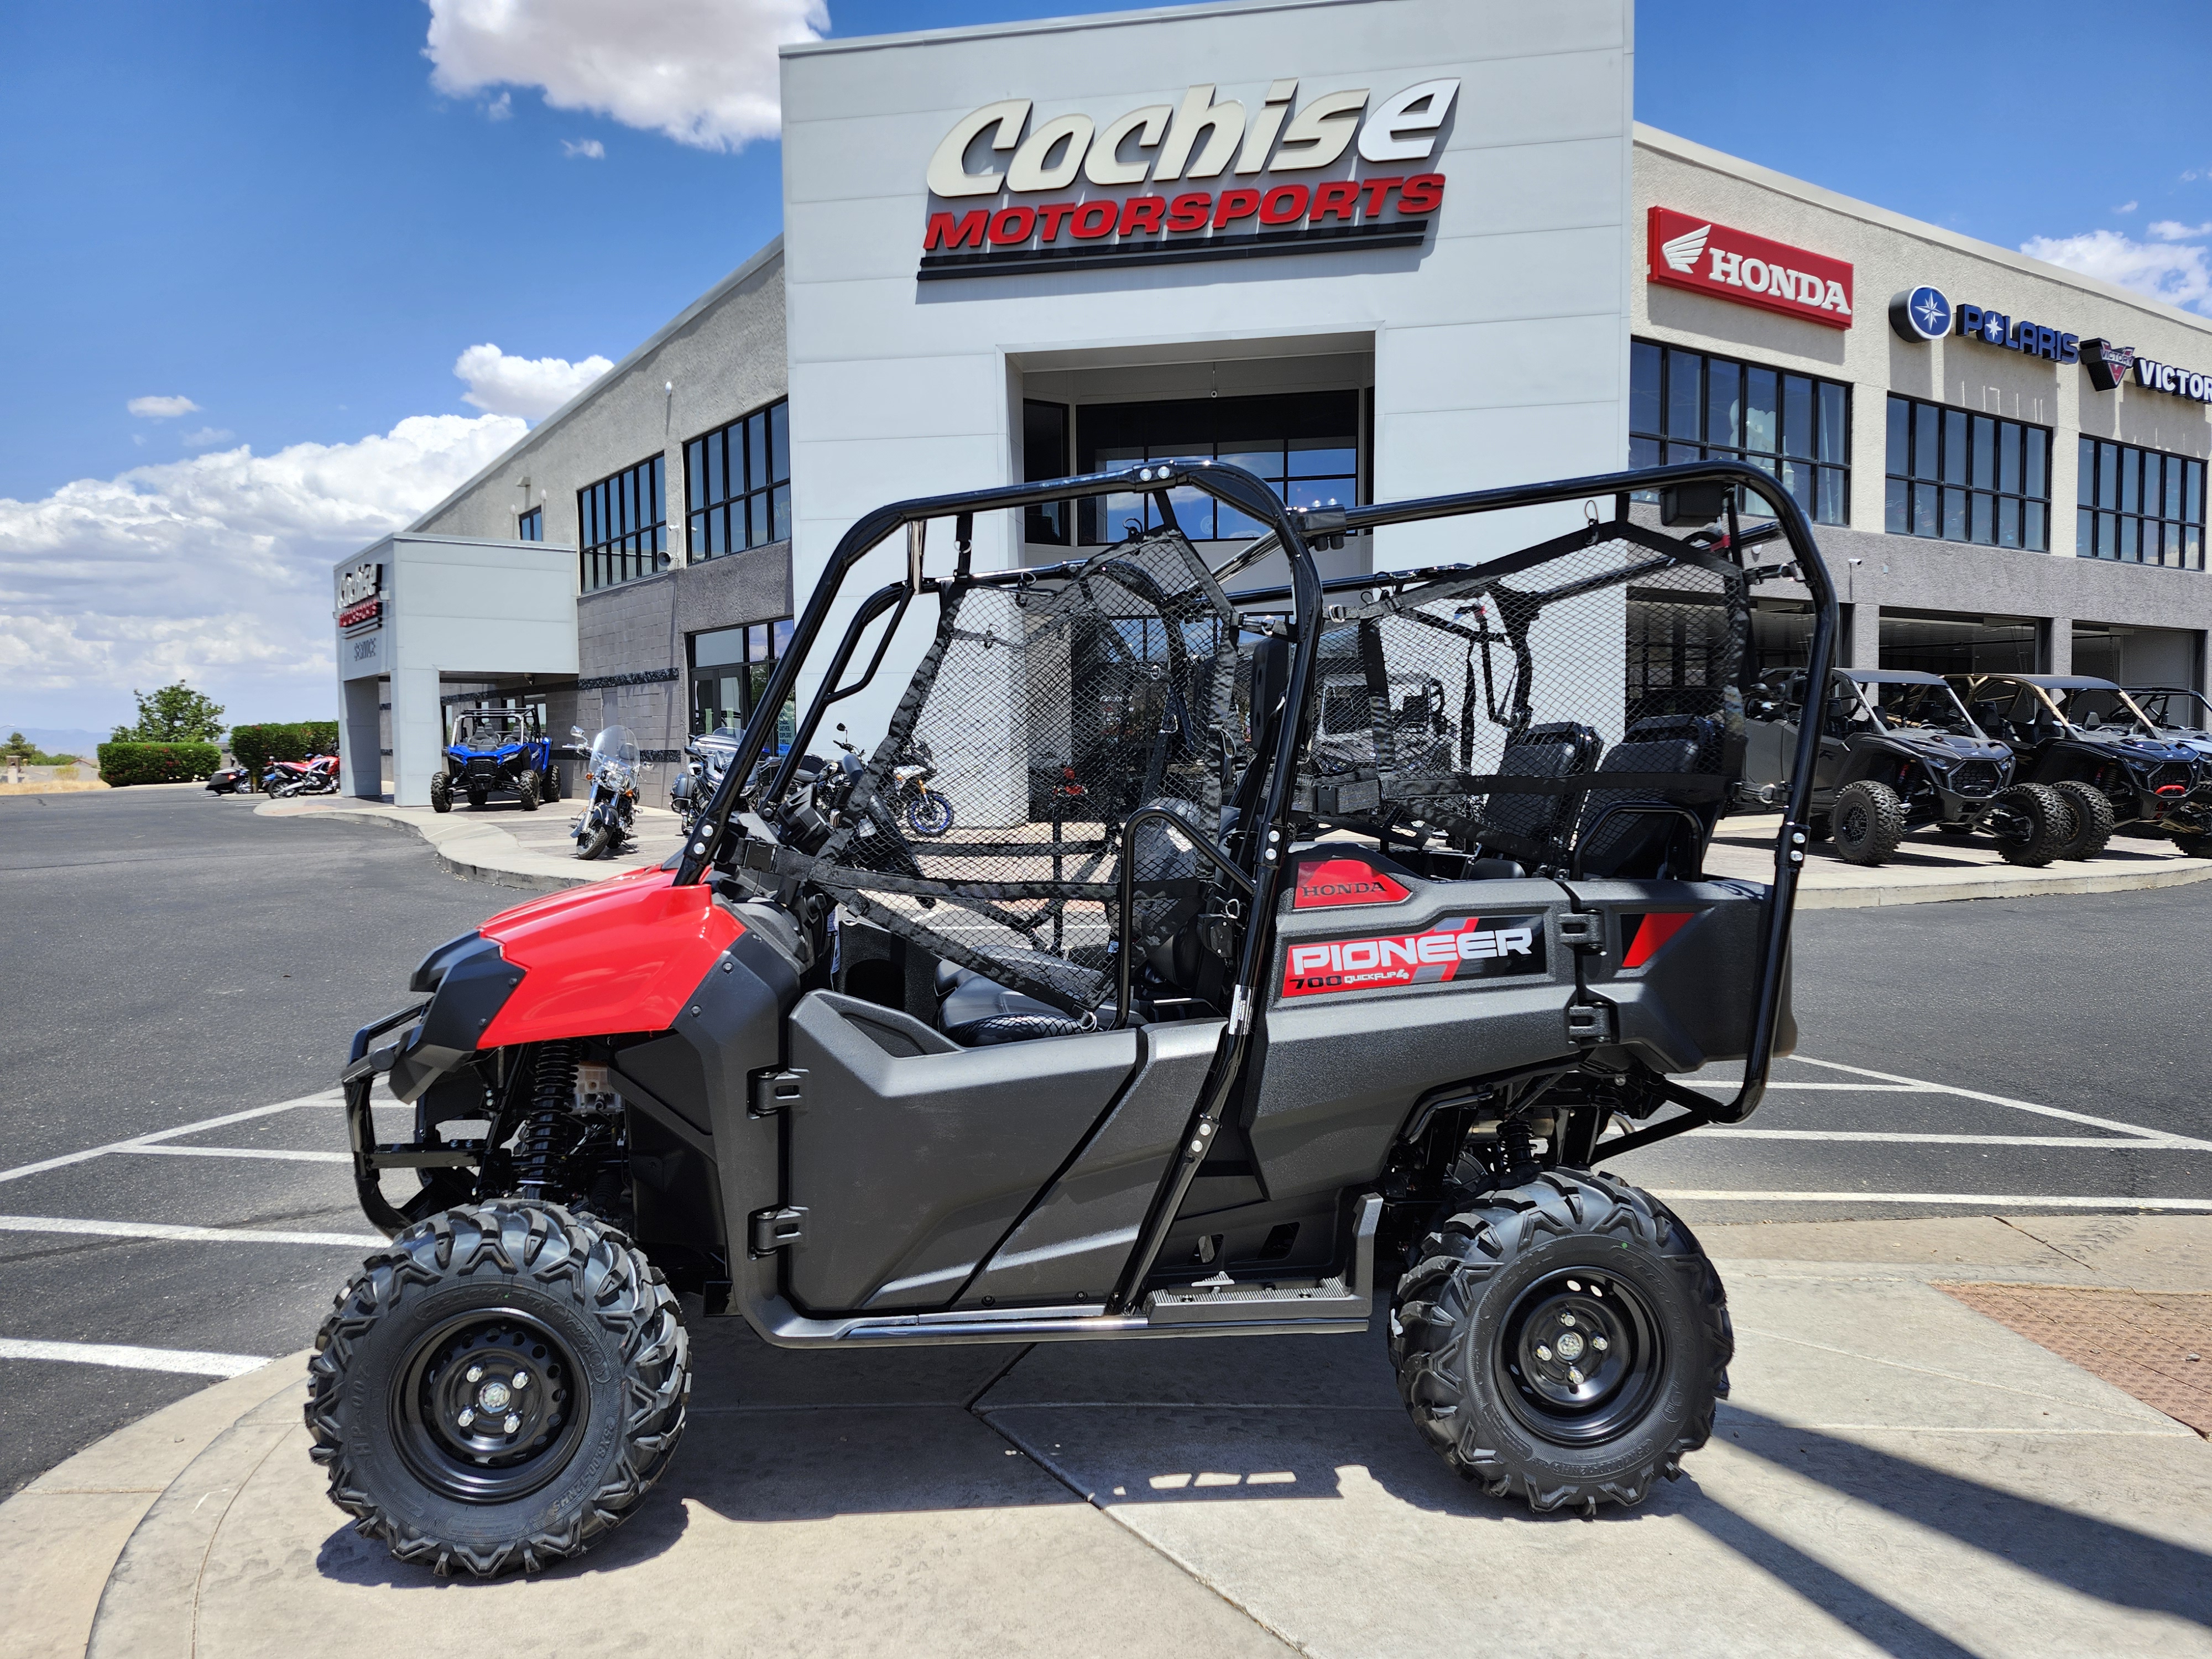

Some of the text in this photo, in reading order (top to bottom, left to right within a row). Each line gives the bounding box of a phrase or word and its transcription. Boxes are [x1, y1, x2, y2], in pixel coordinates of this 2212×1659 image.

[927, 77, 1461, 197] Cochise
[924, 173, 1446, 250] MOTORSPORTS
[1709, 247, 1851, 315] HONDA
[1959, 304, 2079, 364] POLARIS
[2101, 349, 2134, 366] VICTORY
[354, 638, 377, 661] SERVICE
[1302, 881, 1387, 897] HONDA
[1292, 927, 1532, 975] PIONEER
[1289, 975, 1342, 989] 700
